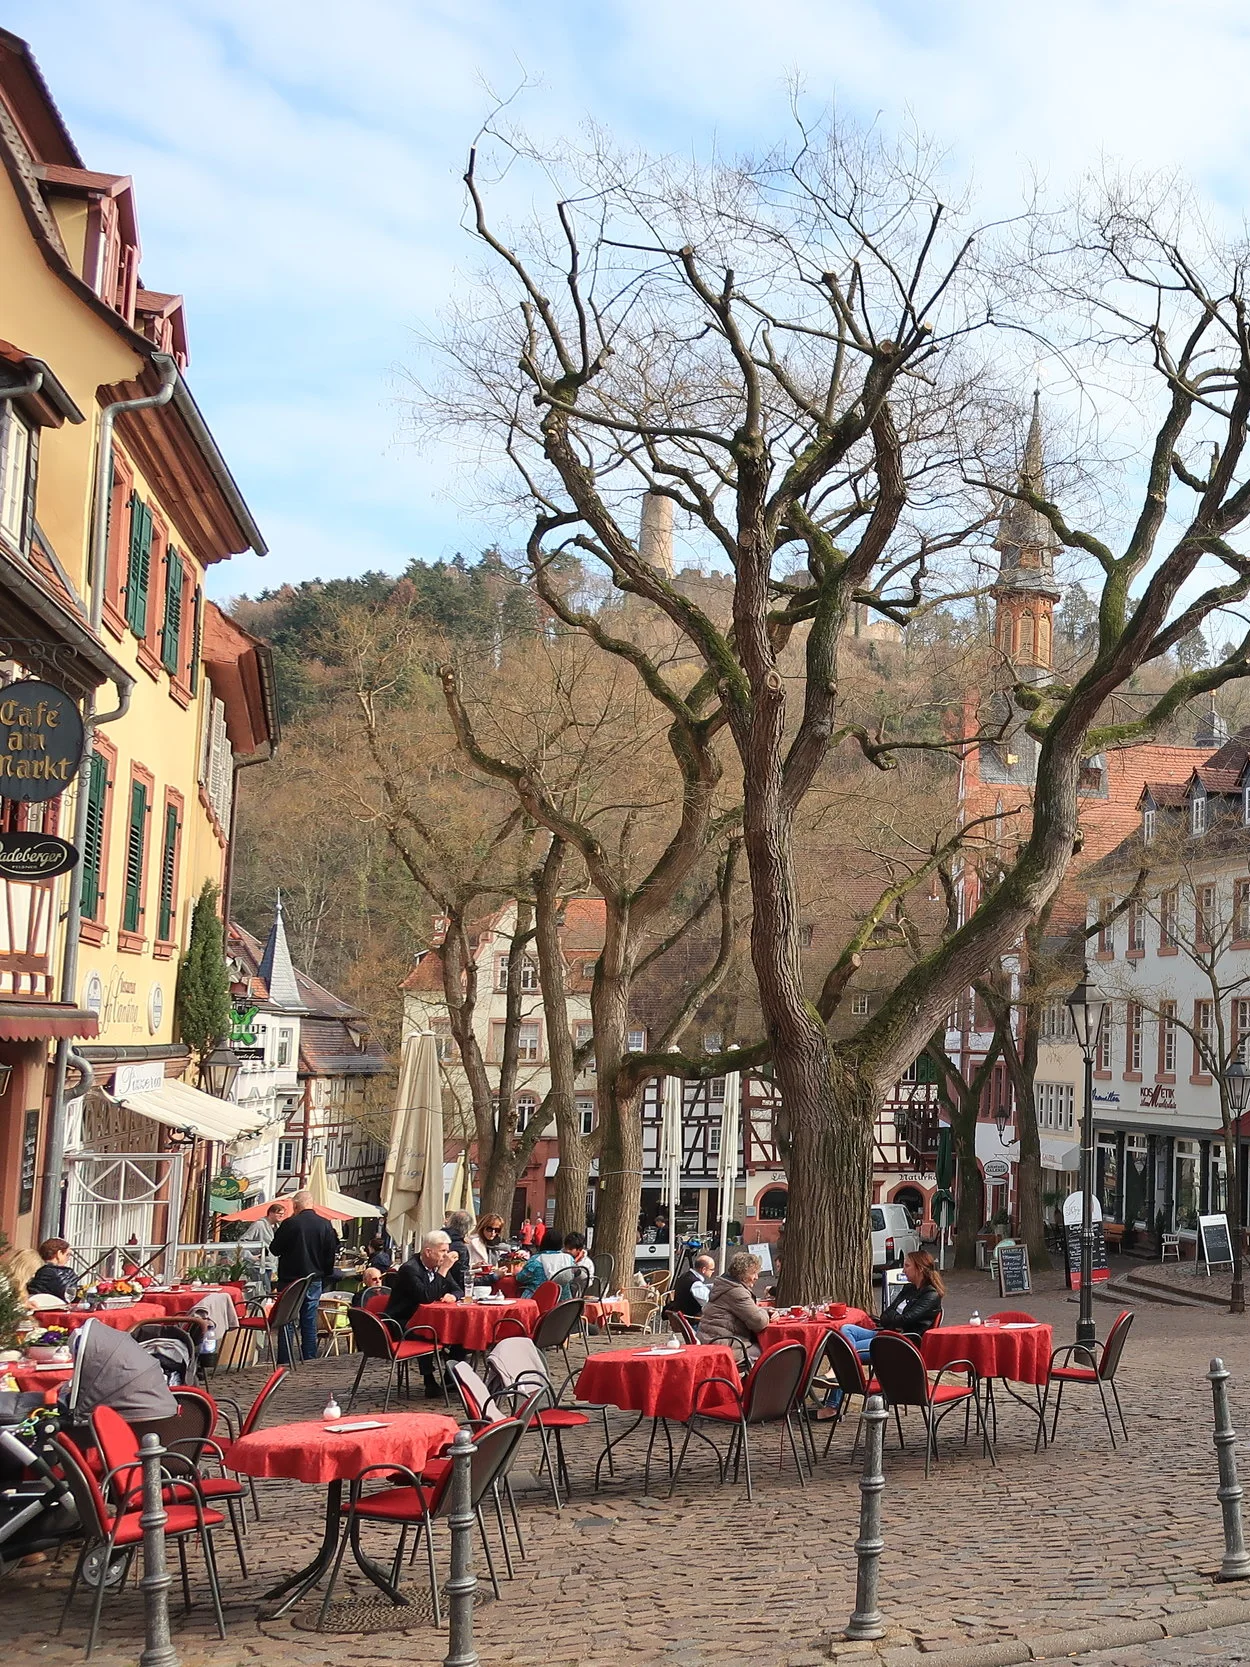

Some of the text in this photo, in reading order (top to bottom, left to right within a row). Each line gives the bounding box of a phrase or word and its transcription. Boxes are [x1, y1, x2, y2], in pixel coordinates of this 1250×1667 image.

[0, 700, 63, 728] Café
[8, 731, 46, 751] am
[229, 1023, 267, 1034] ELDE
[119, 1066, 161, 1094] Pizzeria
[899, 1173, 937, 1181] Naturko
